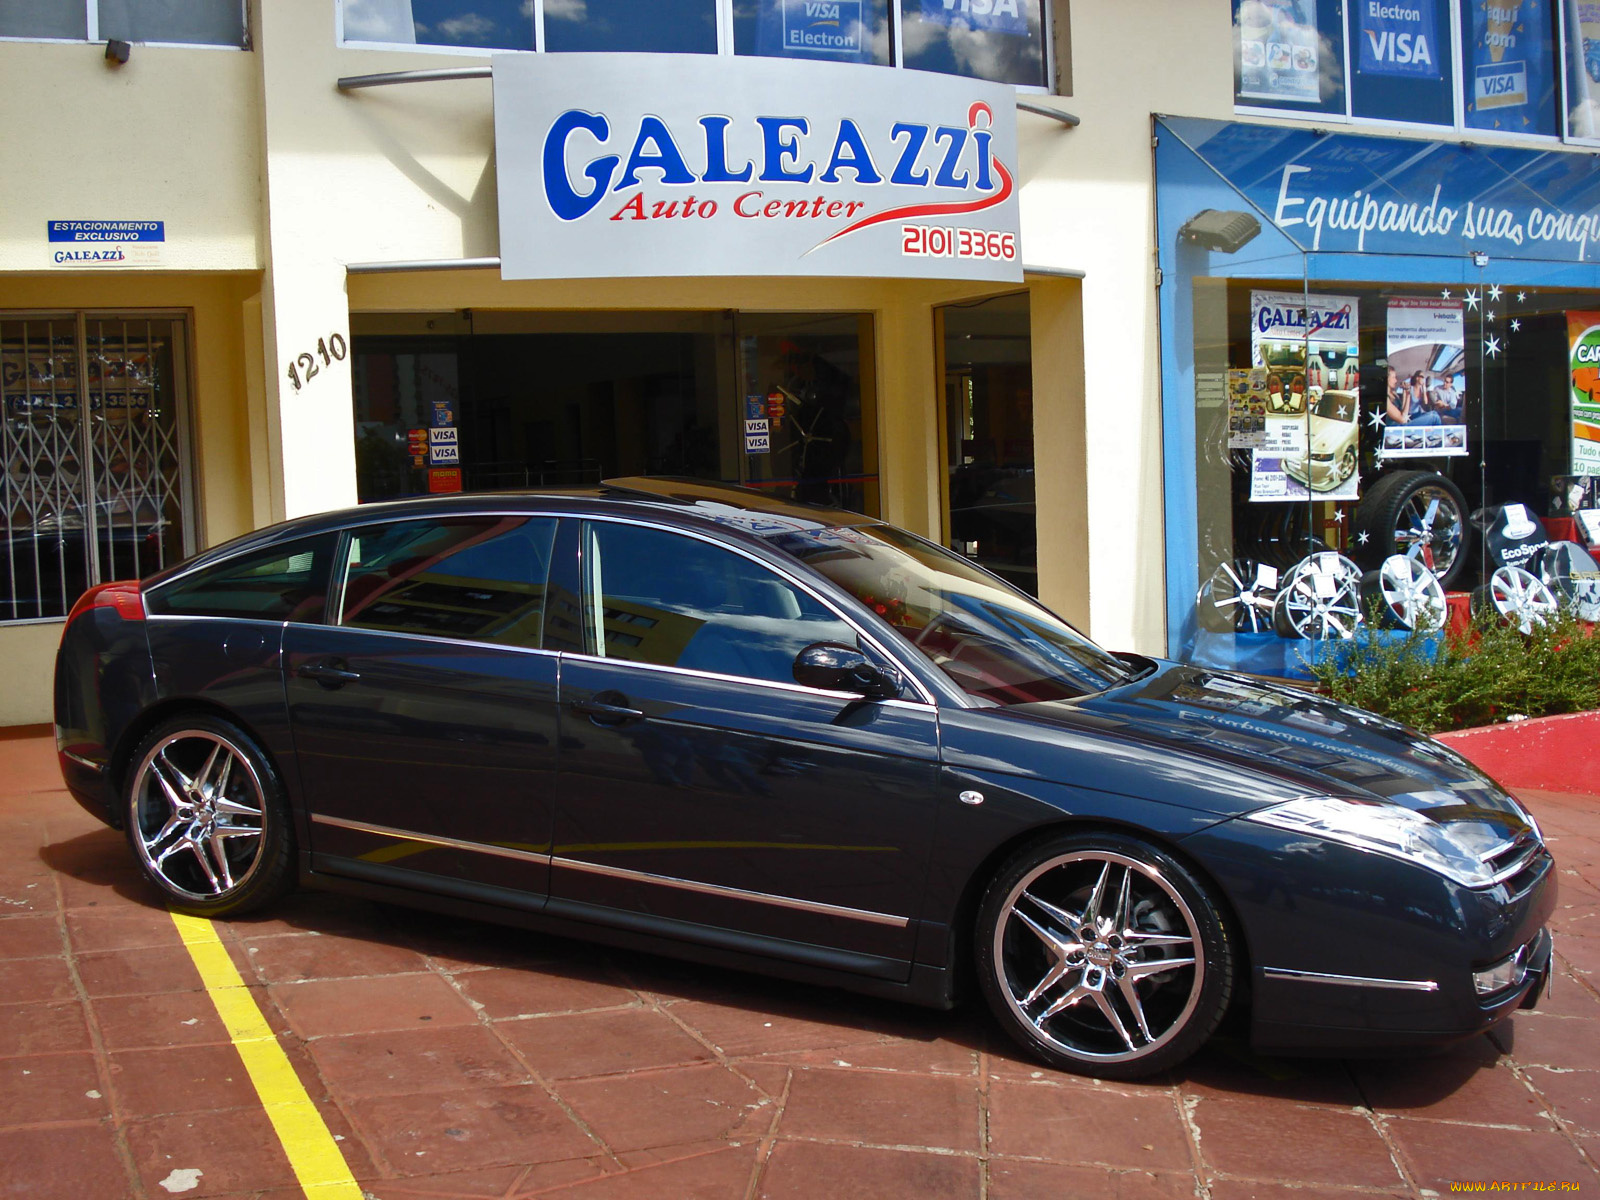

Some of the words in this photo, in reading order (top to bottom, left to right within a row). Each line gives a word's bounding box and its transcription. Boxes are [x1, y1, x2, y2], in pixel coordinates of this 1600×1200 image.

[804, 2, 840, 19] VISA
[1369, 1, 1420, 22] Electron
[1487, 6, 1519, 26] aqui
[790, 30, 854, 46] Electron
[1484, 31, 1516, 48] com
[1363, 29, 1432, 65] VISA
[1483, 76, 1515, 95] VISA
[542, 104, 995, 222] GALEAZZI
[609, 191, 720, 221] Auto
[733, 190, 865, 219] Center
[1275, 164, 1458, 252] Equipando
[53, 222, 158, 231] ESTACIONAMENTO
[74, 232, 139, 241] EXCLUSIVO
[903, 226, 953, 256] 2101
[958, 229, 1016, 260] 3366
[54, 247, 124, 263] GALEAZZI
[288, 332, 347, 390] 1210
[433, 430, 456, 440] VISA
[747, 422, 768, 431] VISA
[748, 438, 768, 447] VISA
[1579, 444, 1597, 457] Tudo
[434, 448, 457, 458] VISA
[1574, 461, 1586, 473] 10
